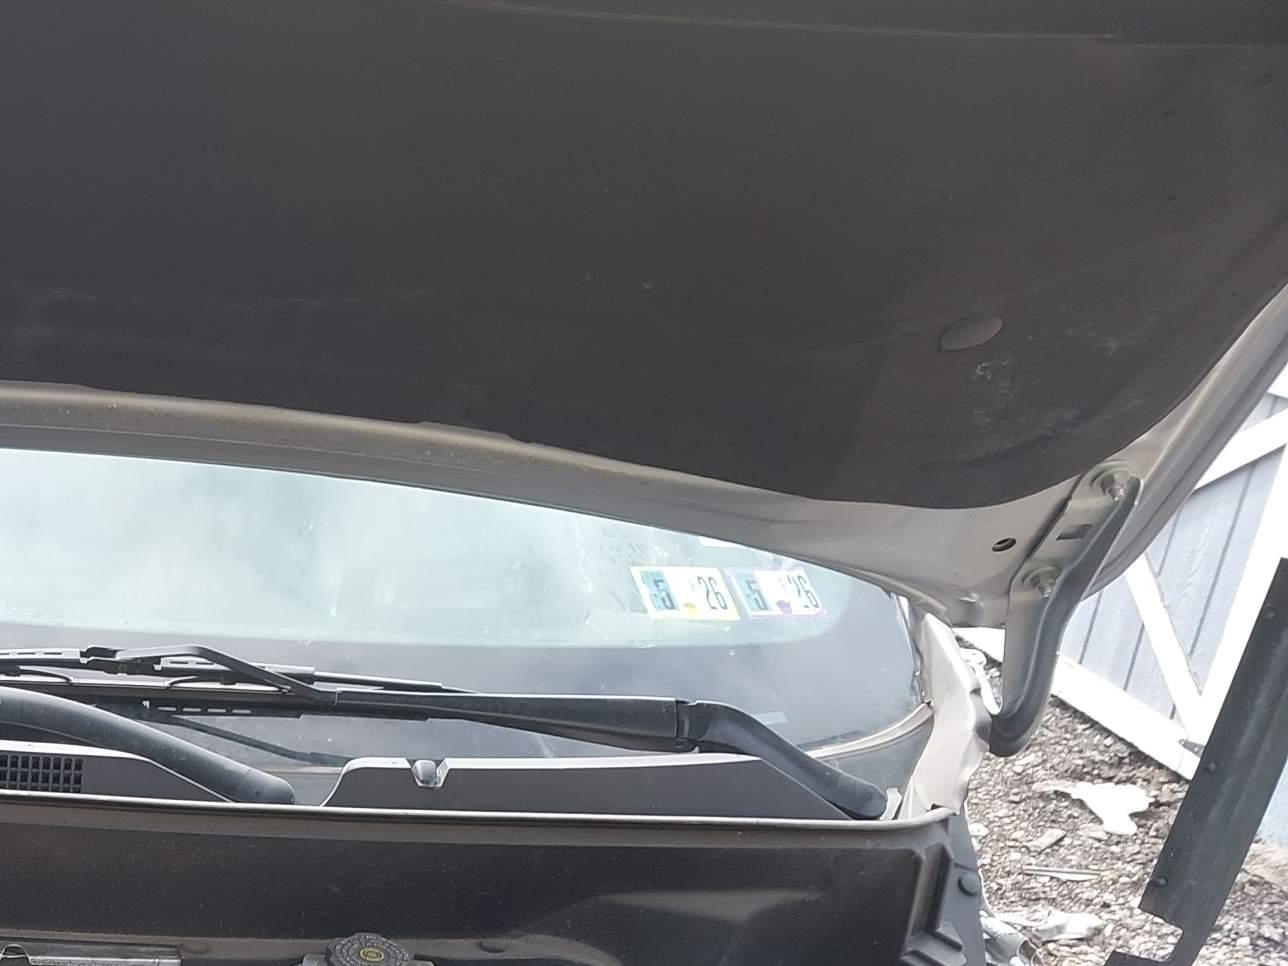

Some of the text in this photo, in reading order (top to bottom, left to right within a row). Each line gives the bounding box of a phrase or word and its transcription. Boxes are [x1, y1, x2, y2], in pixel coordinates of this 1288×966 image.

[652, 576, 728, 610] 5 26
[746, 580, 768, 611] 5
